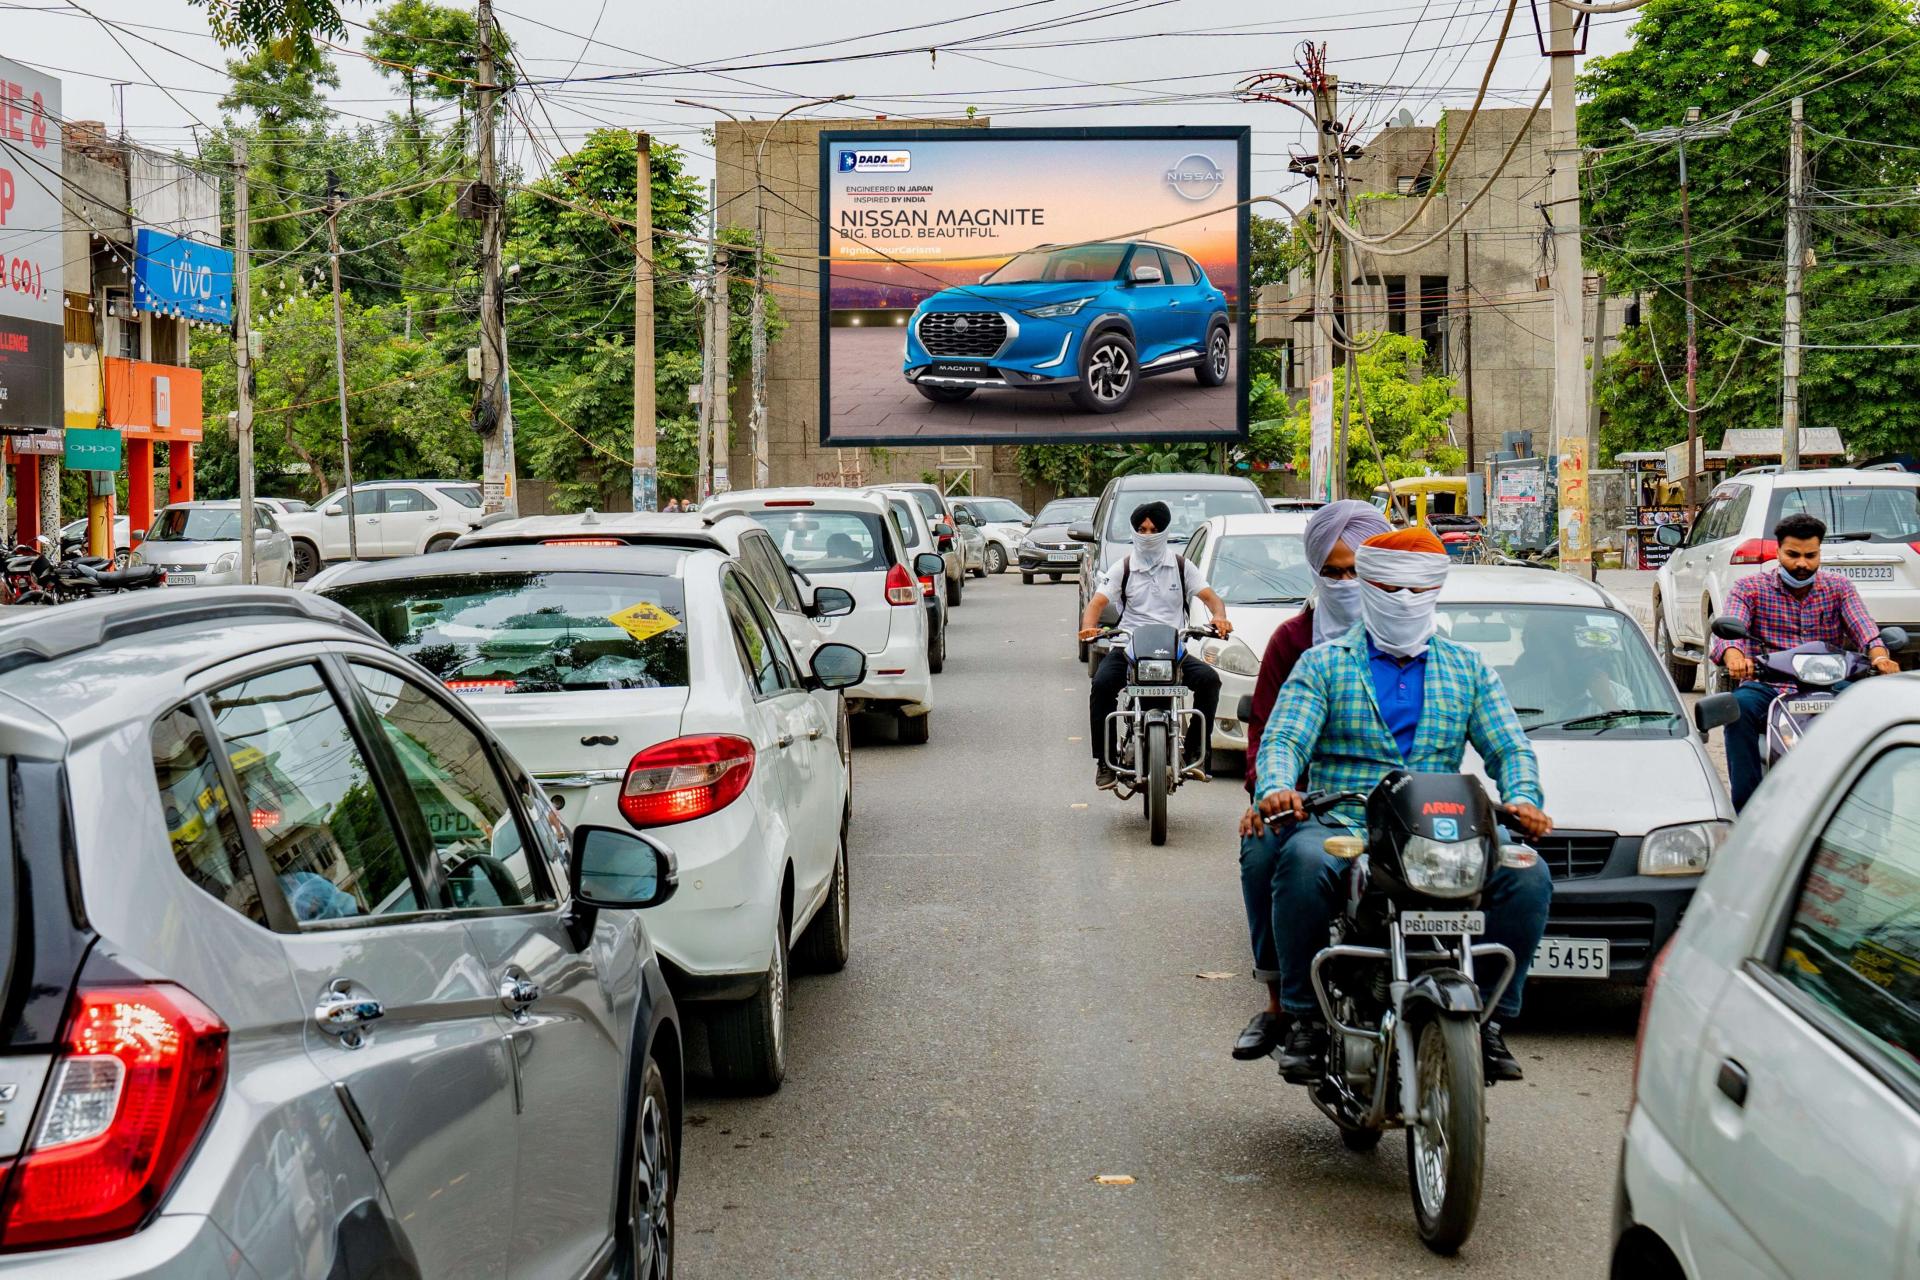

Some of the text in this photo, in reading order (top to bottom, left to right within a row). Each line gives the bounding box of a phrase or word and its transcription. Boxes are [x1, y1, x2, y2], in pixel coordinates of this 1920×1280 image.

[31, 91, 47, 150] &
[858, 155, 888, 164] DADA
[1167, 172, 1225, 181] NISSAN
[846, 185, 896, 193] ENGINEERED
[841, 208, 1045, 227] NISSAN MAGNITE
[840, 227, 1000, 239] BIG. BOLD. BEAUTIFUL.
[171, 249, 212, 300] vivo
[1422, 801, 1466, 816] ARMY
[1548, 945, 1604, 970] 5455
